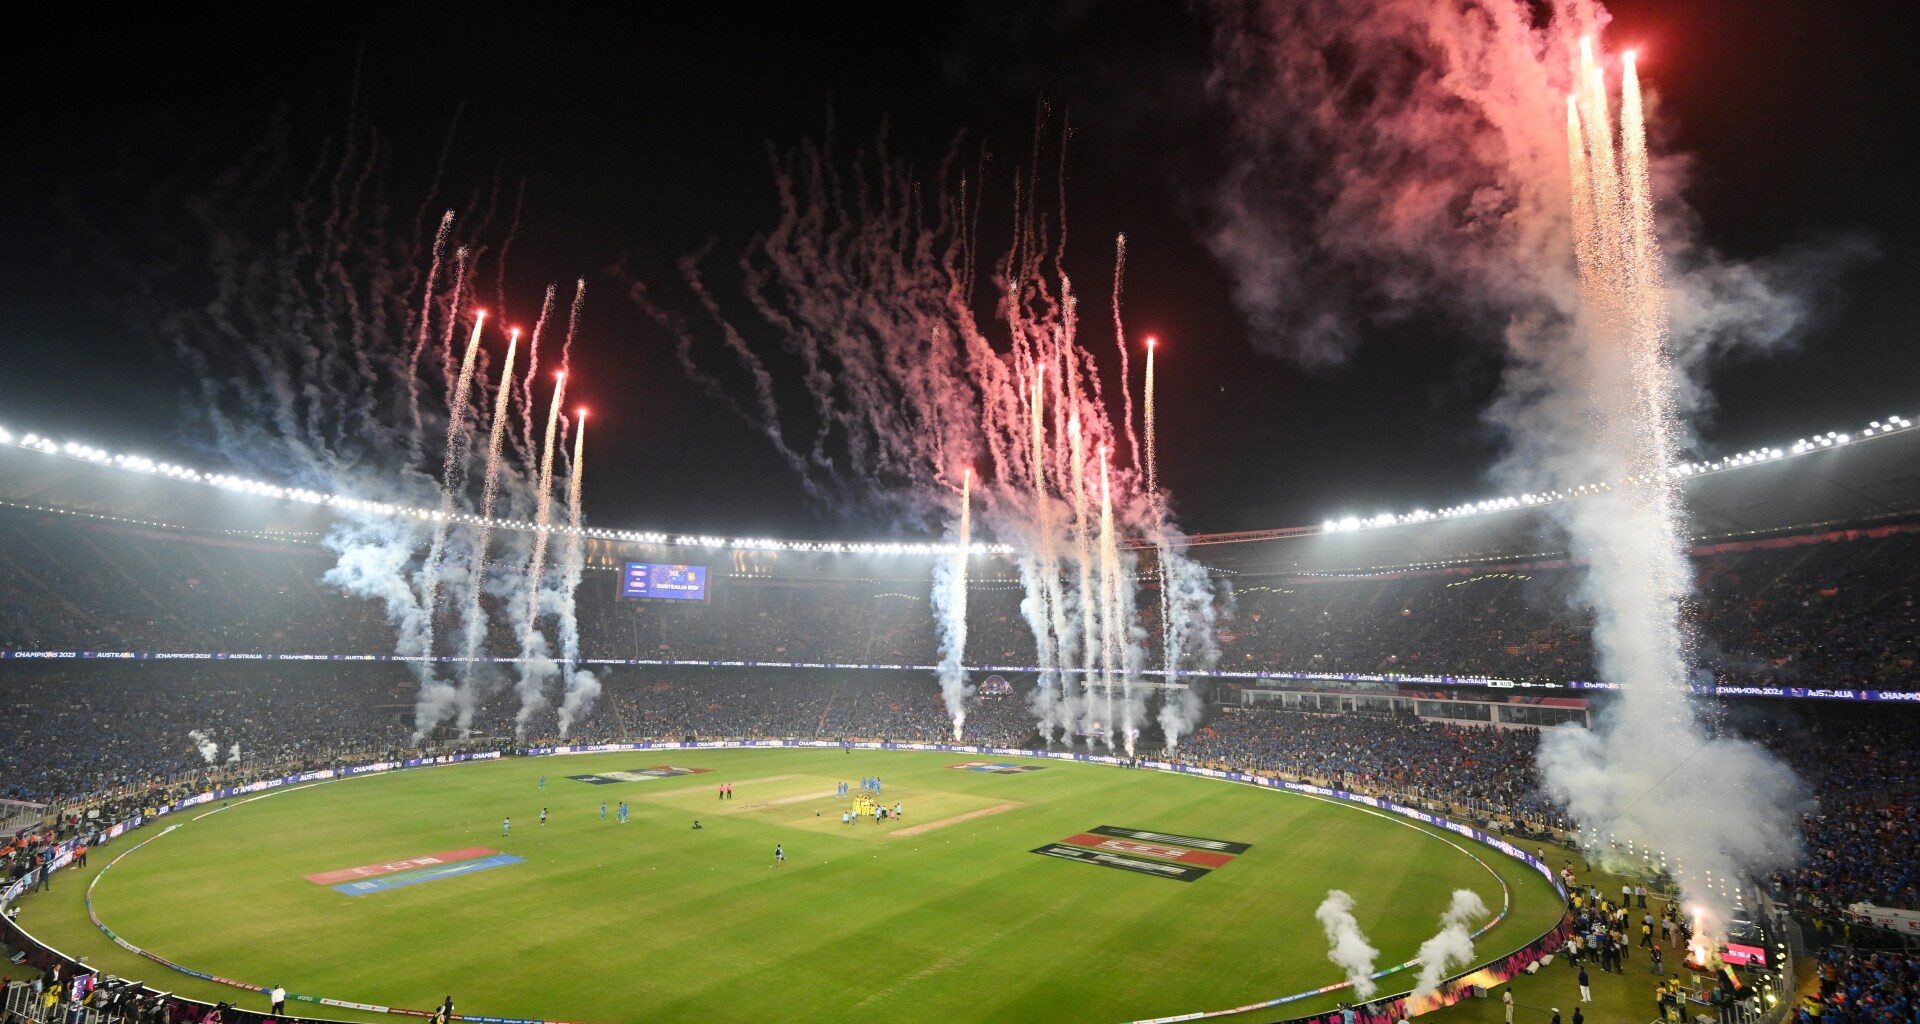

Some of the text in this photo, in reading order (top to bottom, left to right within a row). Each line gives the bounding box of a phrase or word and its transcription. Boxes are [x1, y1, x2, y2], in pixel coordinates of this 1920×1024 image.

[1718, 687, 1762, 695] CHAMPIONS
[183, 792, 214, 807] AUSTRALIA
[267, 778, 282, 788] 2023
[300, 770, 334, 781] AUSTRALIA
[353, 763, 388, 773] CHAMPIONS
[951, 745, 977, 753] AUSTRALIA
[1047, 752, 1075, 760] AUSTRALIA
[1285, 781, 1318, 794] CHAMPIONS
[1317, 787, 1332, 796] 2023
[1350, 793, 1378, 807] AUSTRALIA
[1391, 804, 1420, 820] CHAMPIONS
[1418, 812, 1432, 822] 2023
[1446, 820, 1474, 839] AUSTRALIA
